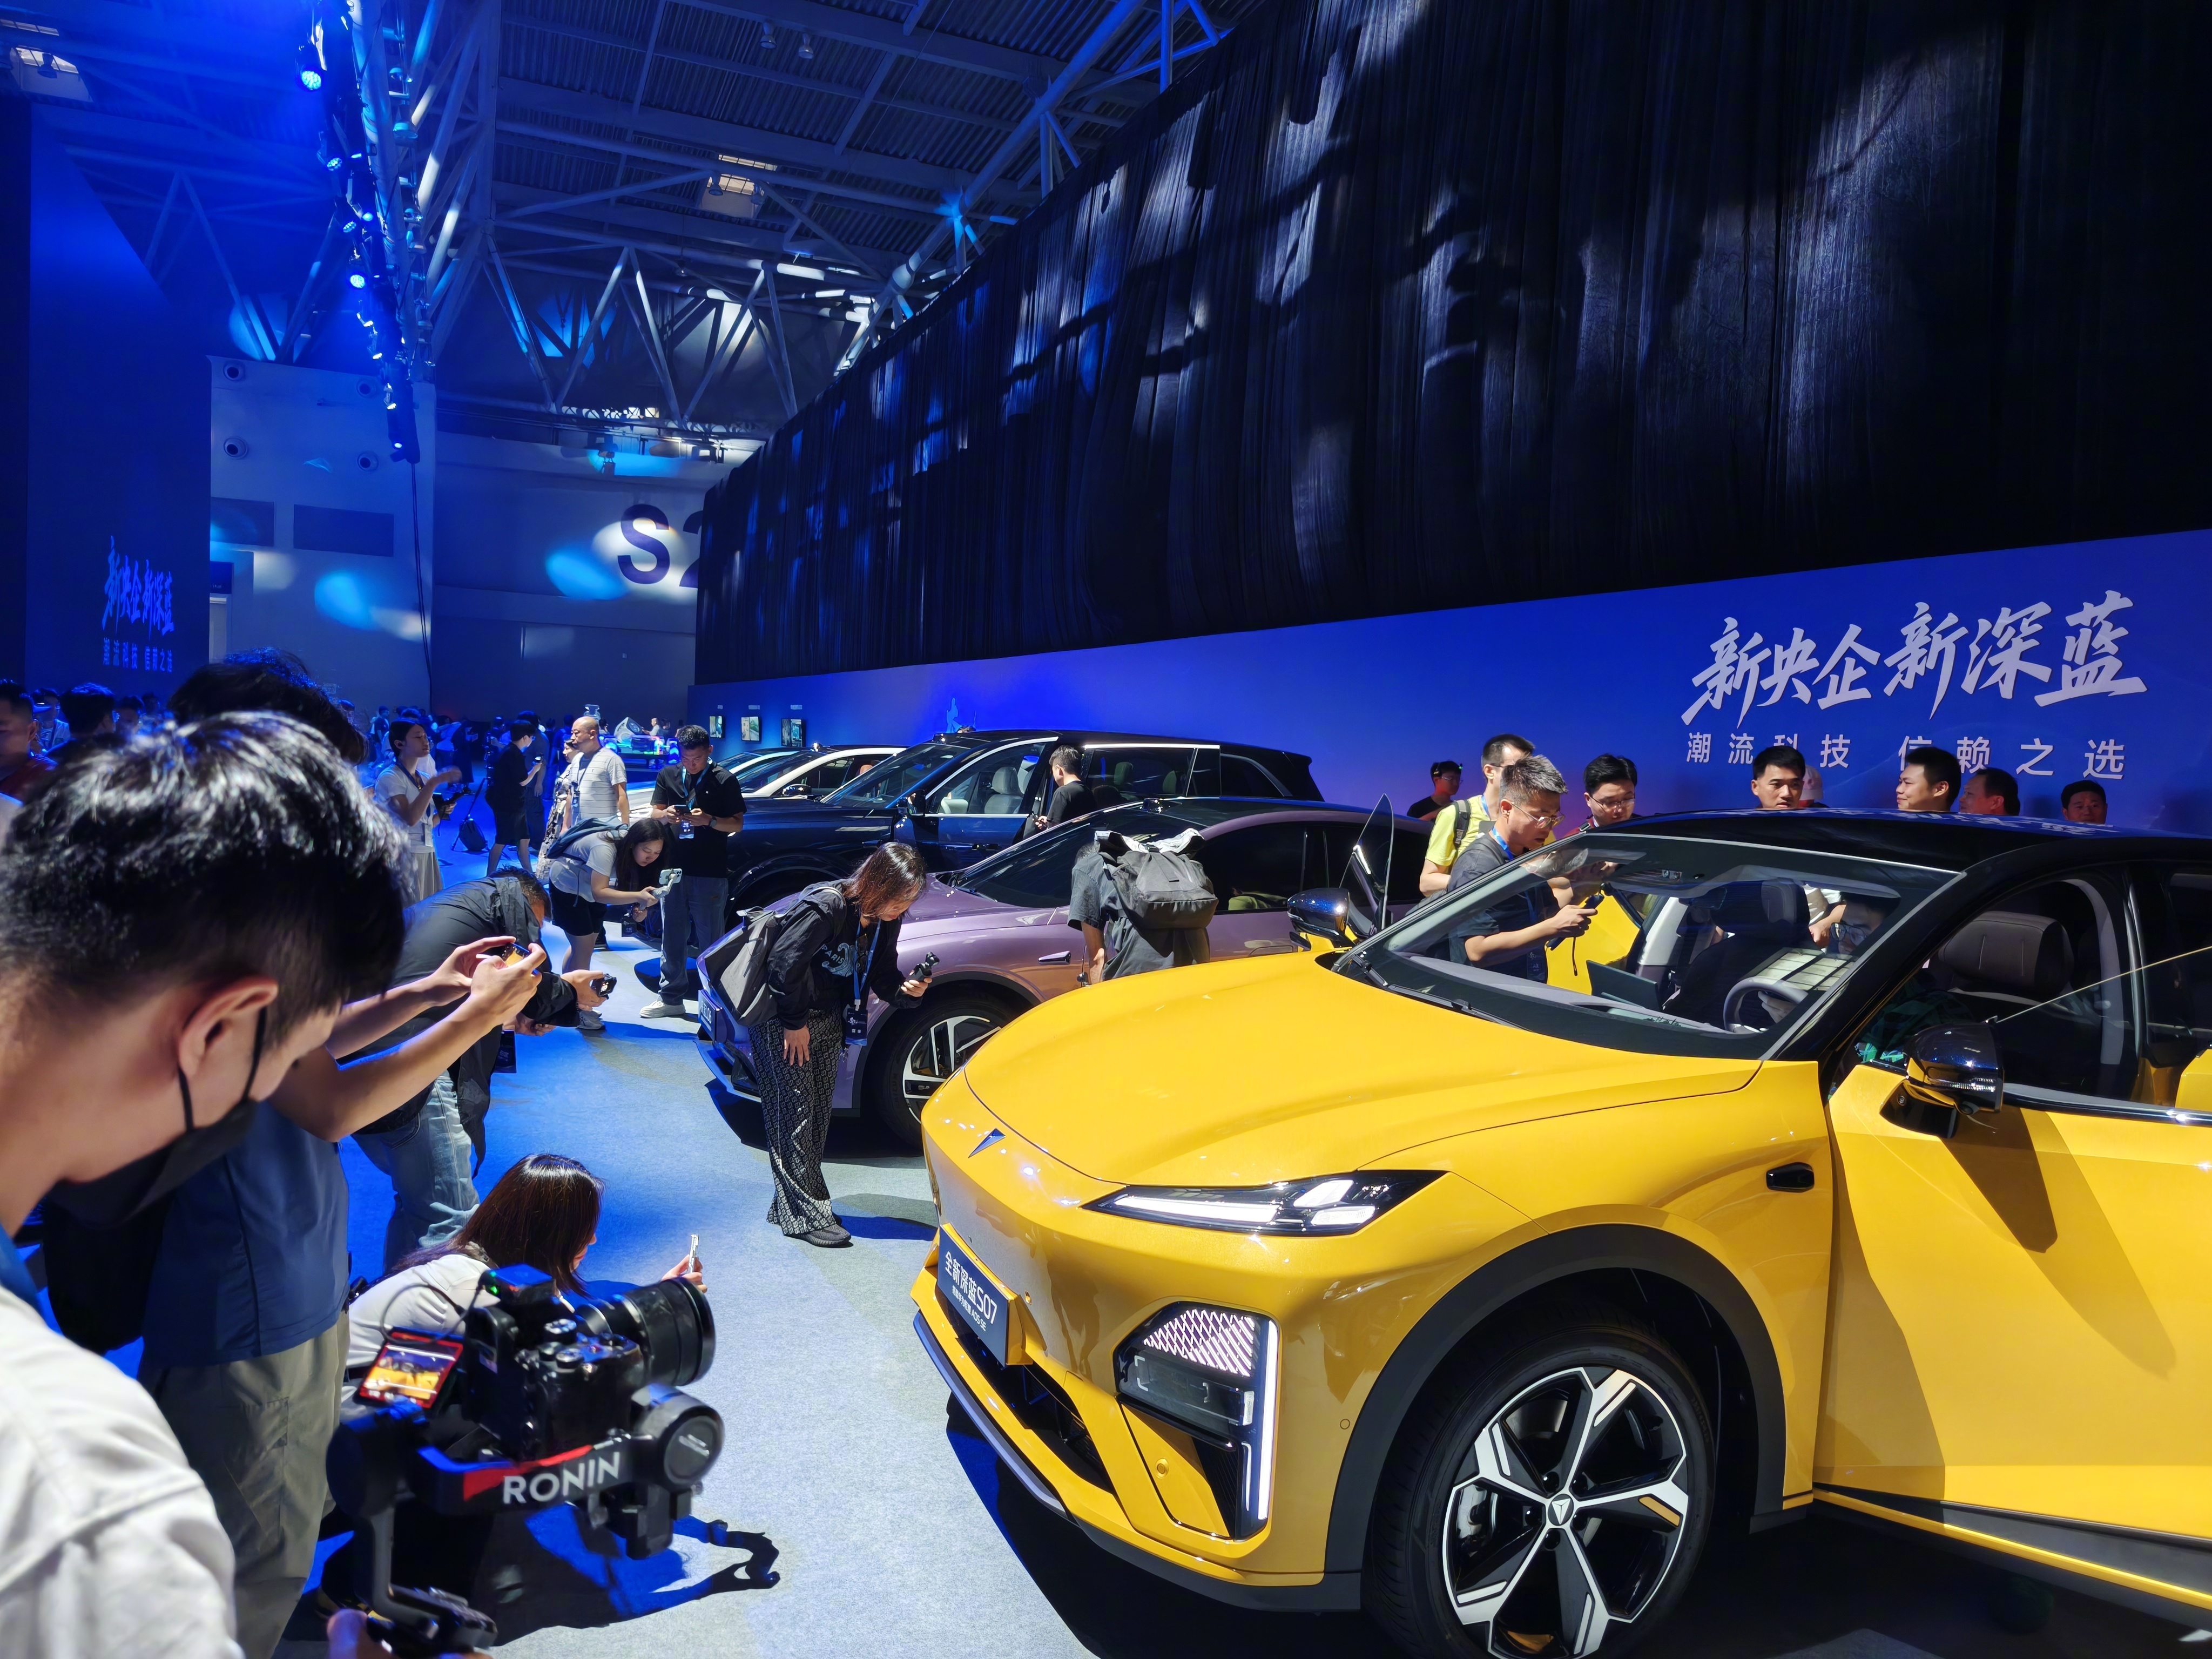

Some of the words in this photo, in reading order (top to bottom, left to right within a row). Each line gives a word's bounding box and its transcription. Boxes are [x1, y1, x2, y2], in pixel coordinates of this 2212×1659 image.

[1681, 590, 2148, 729] 新央企新深蓝
[945, 1251, 997, 1325] 全新深蓝S07
[503, 1451, 621, 1505] RONIN
